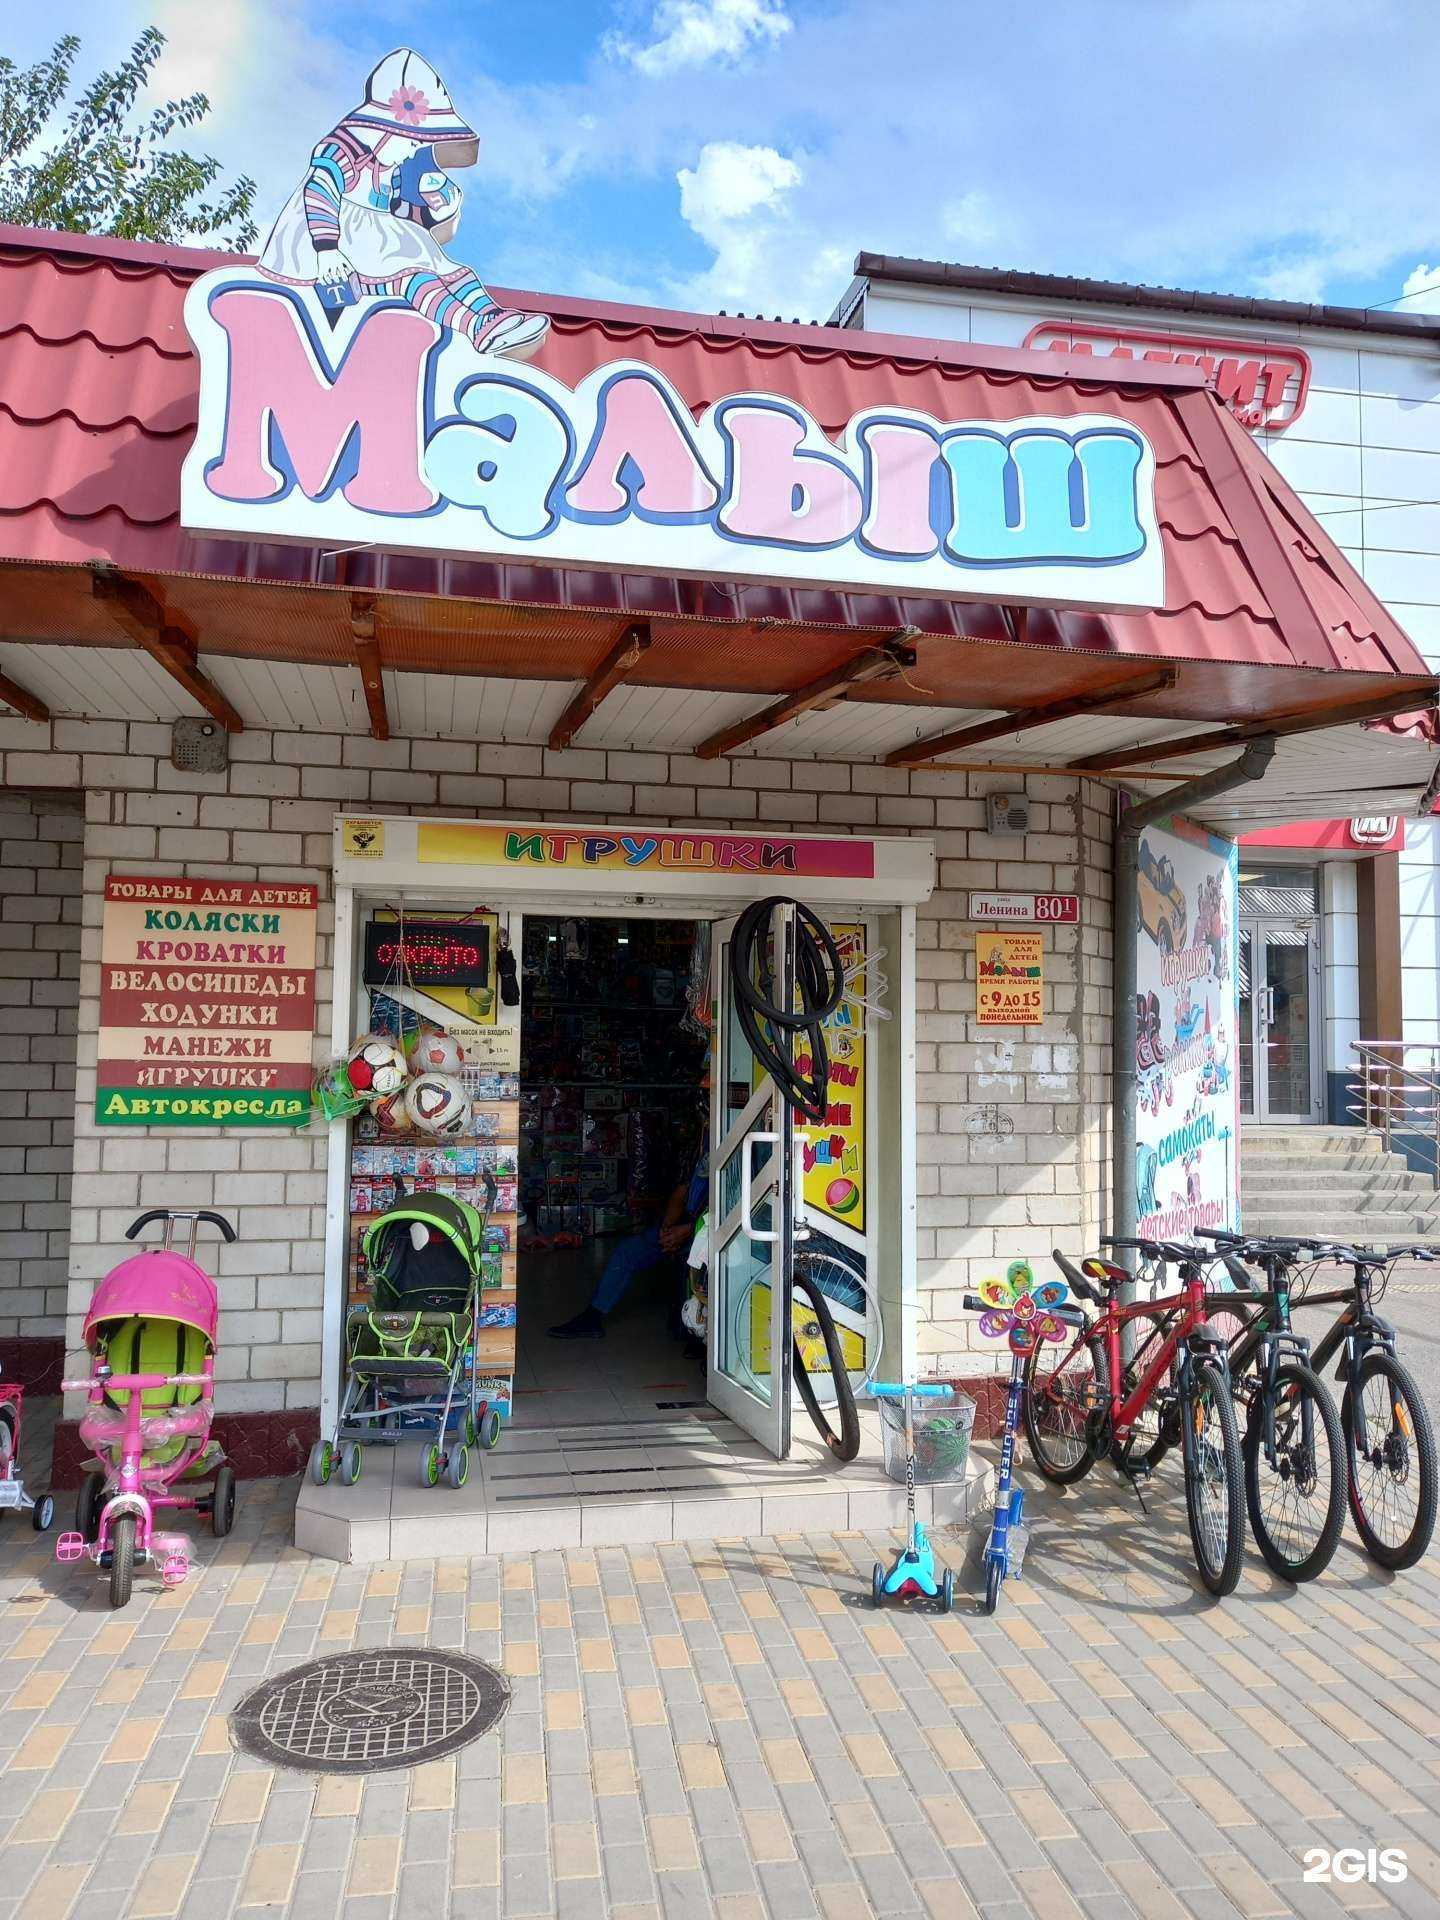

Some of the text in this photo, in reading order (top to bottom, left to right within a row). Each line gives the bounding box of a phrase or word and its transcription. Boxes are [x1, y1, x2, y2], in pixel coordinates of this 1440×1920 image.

[203, 279, 1147, 570] Малыш
[505, 832, 798, 871] ИГРУШКИ
[110, 882, 312, 905] ТОВАРЫ ДЛЯ ДЕТЕЙ
[976, 902, 1028, 916] Ленина
[144, 909, 280, 934] КОЛЯСКИ
[136, 940, 286, 964] КРОВАТКИ
[377, 943, 480, 965] ОТКРЫТО
[1008, 953, 1038, 961] ДЕТЕЙ
[110, 970, 306, 997] ВЕЛОСИПЕДЫ
[991, 990, 1002, 1006] 9
[1022, 990, 1041, 1006] 15
[140, 1002, 278, 1026] ХОДУНКИ
[143, 1035, 272, 1057] МАНЕЖИ
[104, 1093, 303, 1119] Автокресла
